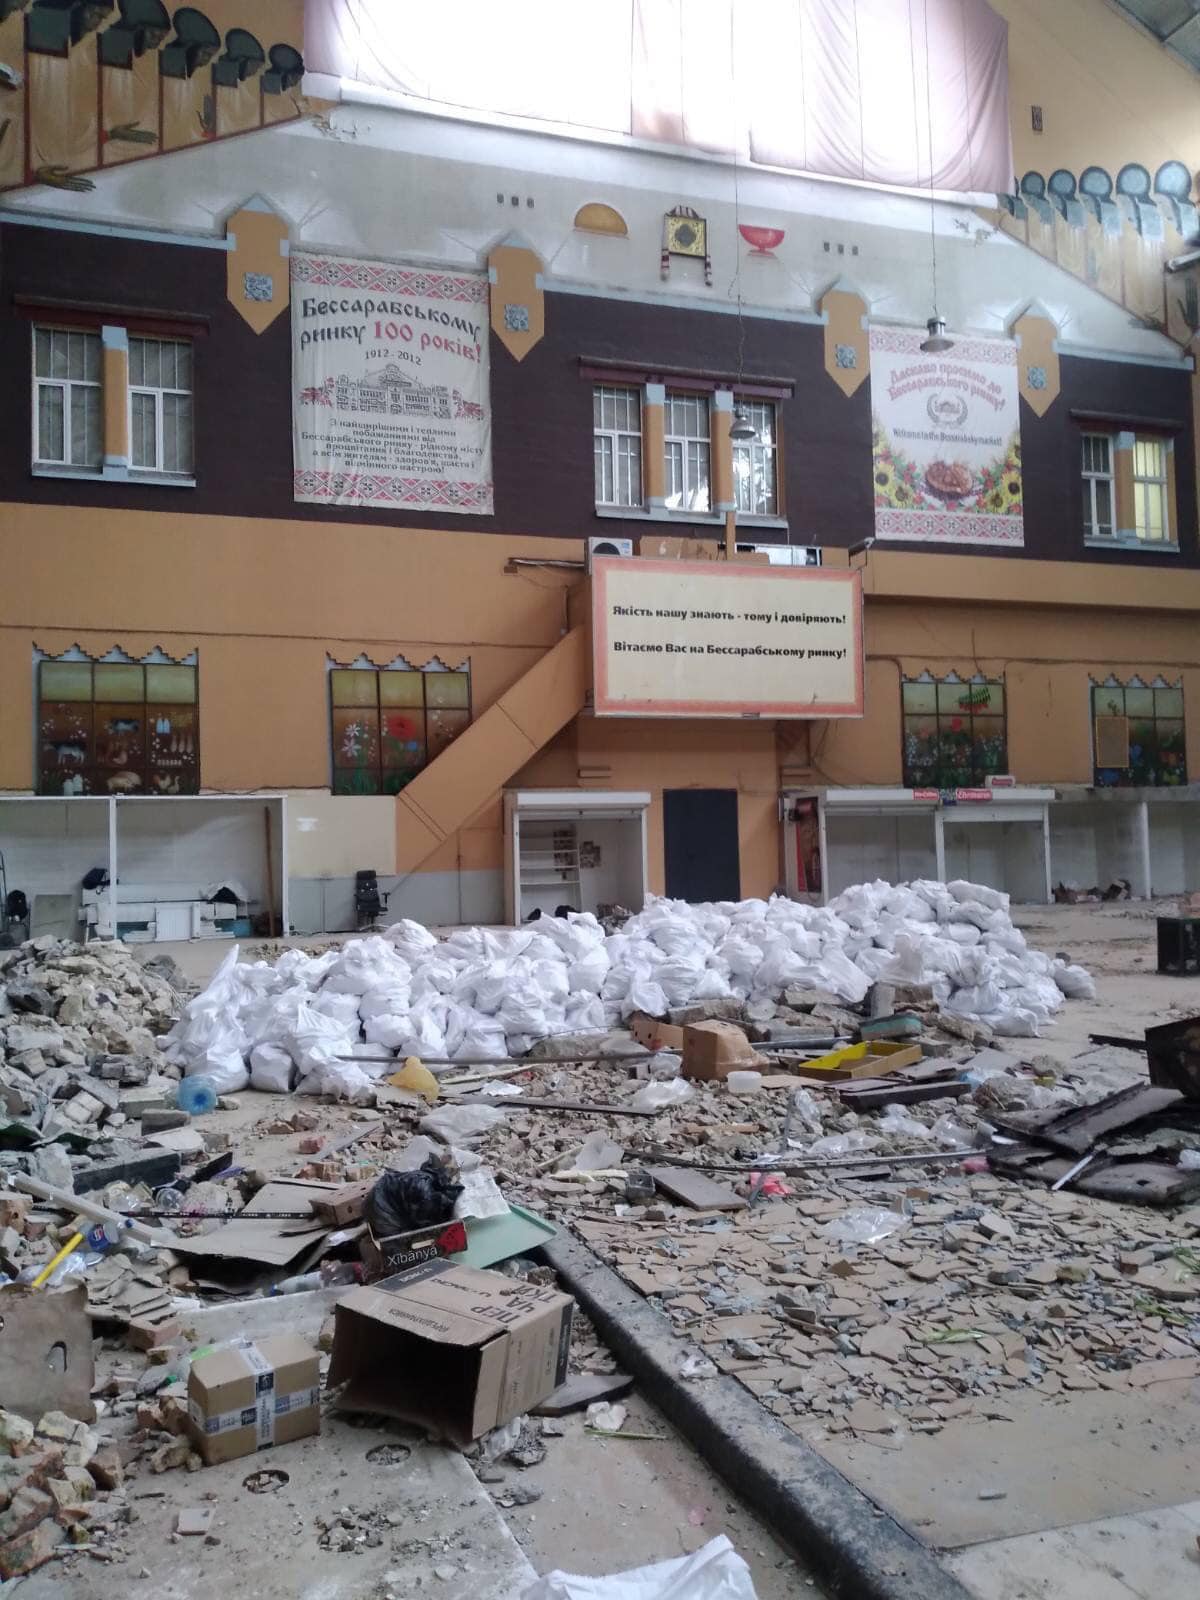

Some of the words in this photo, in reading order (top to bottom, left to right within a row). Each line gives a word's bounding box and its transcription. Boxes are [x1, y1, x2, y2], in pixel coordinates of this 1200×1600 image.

[303, 298, 480, 342] Бессарабському
[301, 325, 366, 351] ринку
[374, 320, 414, 342] 100
[420, 333, 481, 363] років!
[301, 431, 382, 446] Бессарабського
[384, 440, 412, 449] ринку
[420, 442, 458, 453] рідному
[422, 434, 436, 443] від
[326, 443, 387, 454] процвітання
[344, 452, 387, 461] жителям
[613, 606, 653, 617] Якість
[656, 609, 688, 620] нашу
[690, 611, 735, 620] знають
[744, 614, 772, 624] тому
[781, 613, 847, 625] довіряють!
[614, 641, 663, 652] Вітаємо
[665, 644, 688, 653] Вас
[707, 644, 805, 659] Бессарабському
[807, 648, 847, 659] ринку!
[506, 1296, 535, 1313] ЧА
[471, 1305, 521, 1324] ПЕР
